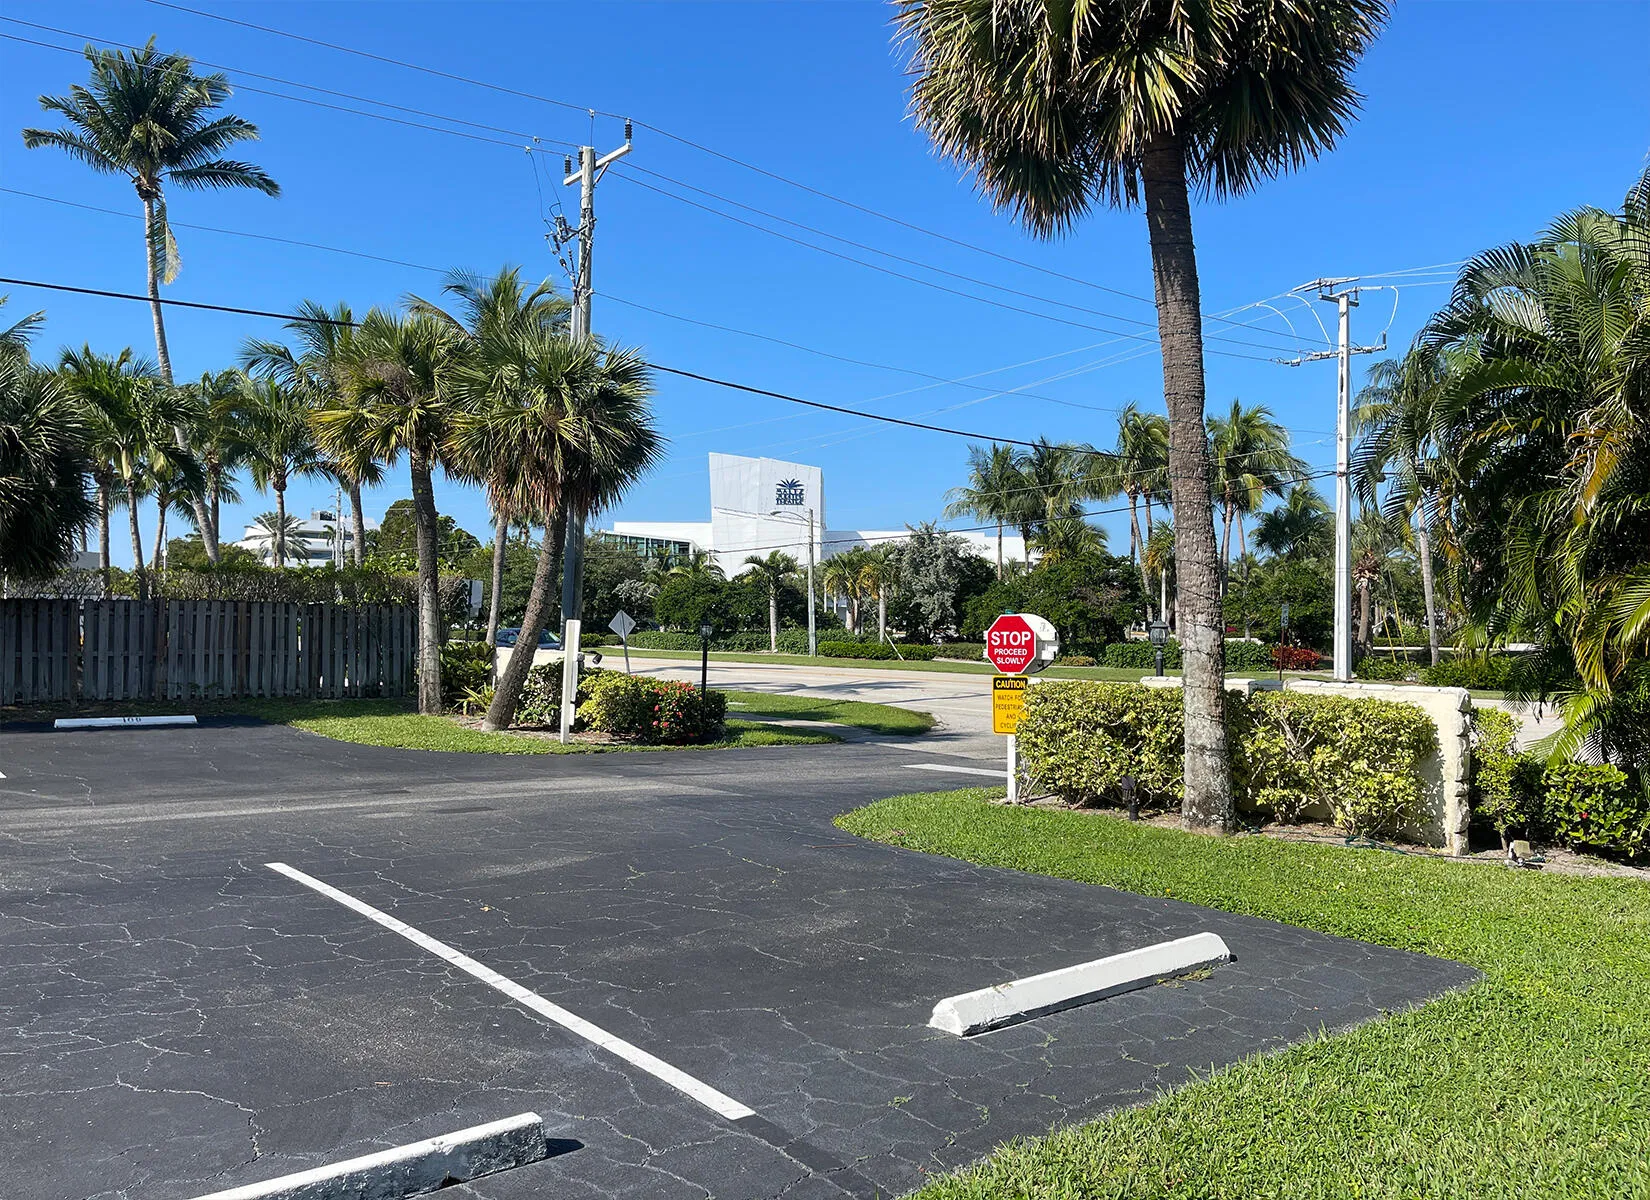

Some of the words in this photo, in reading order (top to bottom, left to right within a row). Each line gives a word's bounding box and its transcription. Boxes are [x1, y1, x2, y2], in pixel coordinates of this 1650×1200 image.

[990, 631, 1032, 646] STOP
[994, 648, 1028, 656] PROCEED
[996, 657, 1025, 665] SLOWLY
[995, 680, 1026, 689] CAUTION
